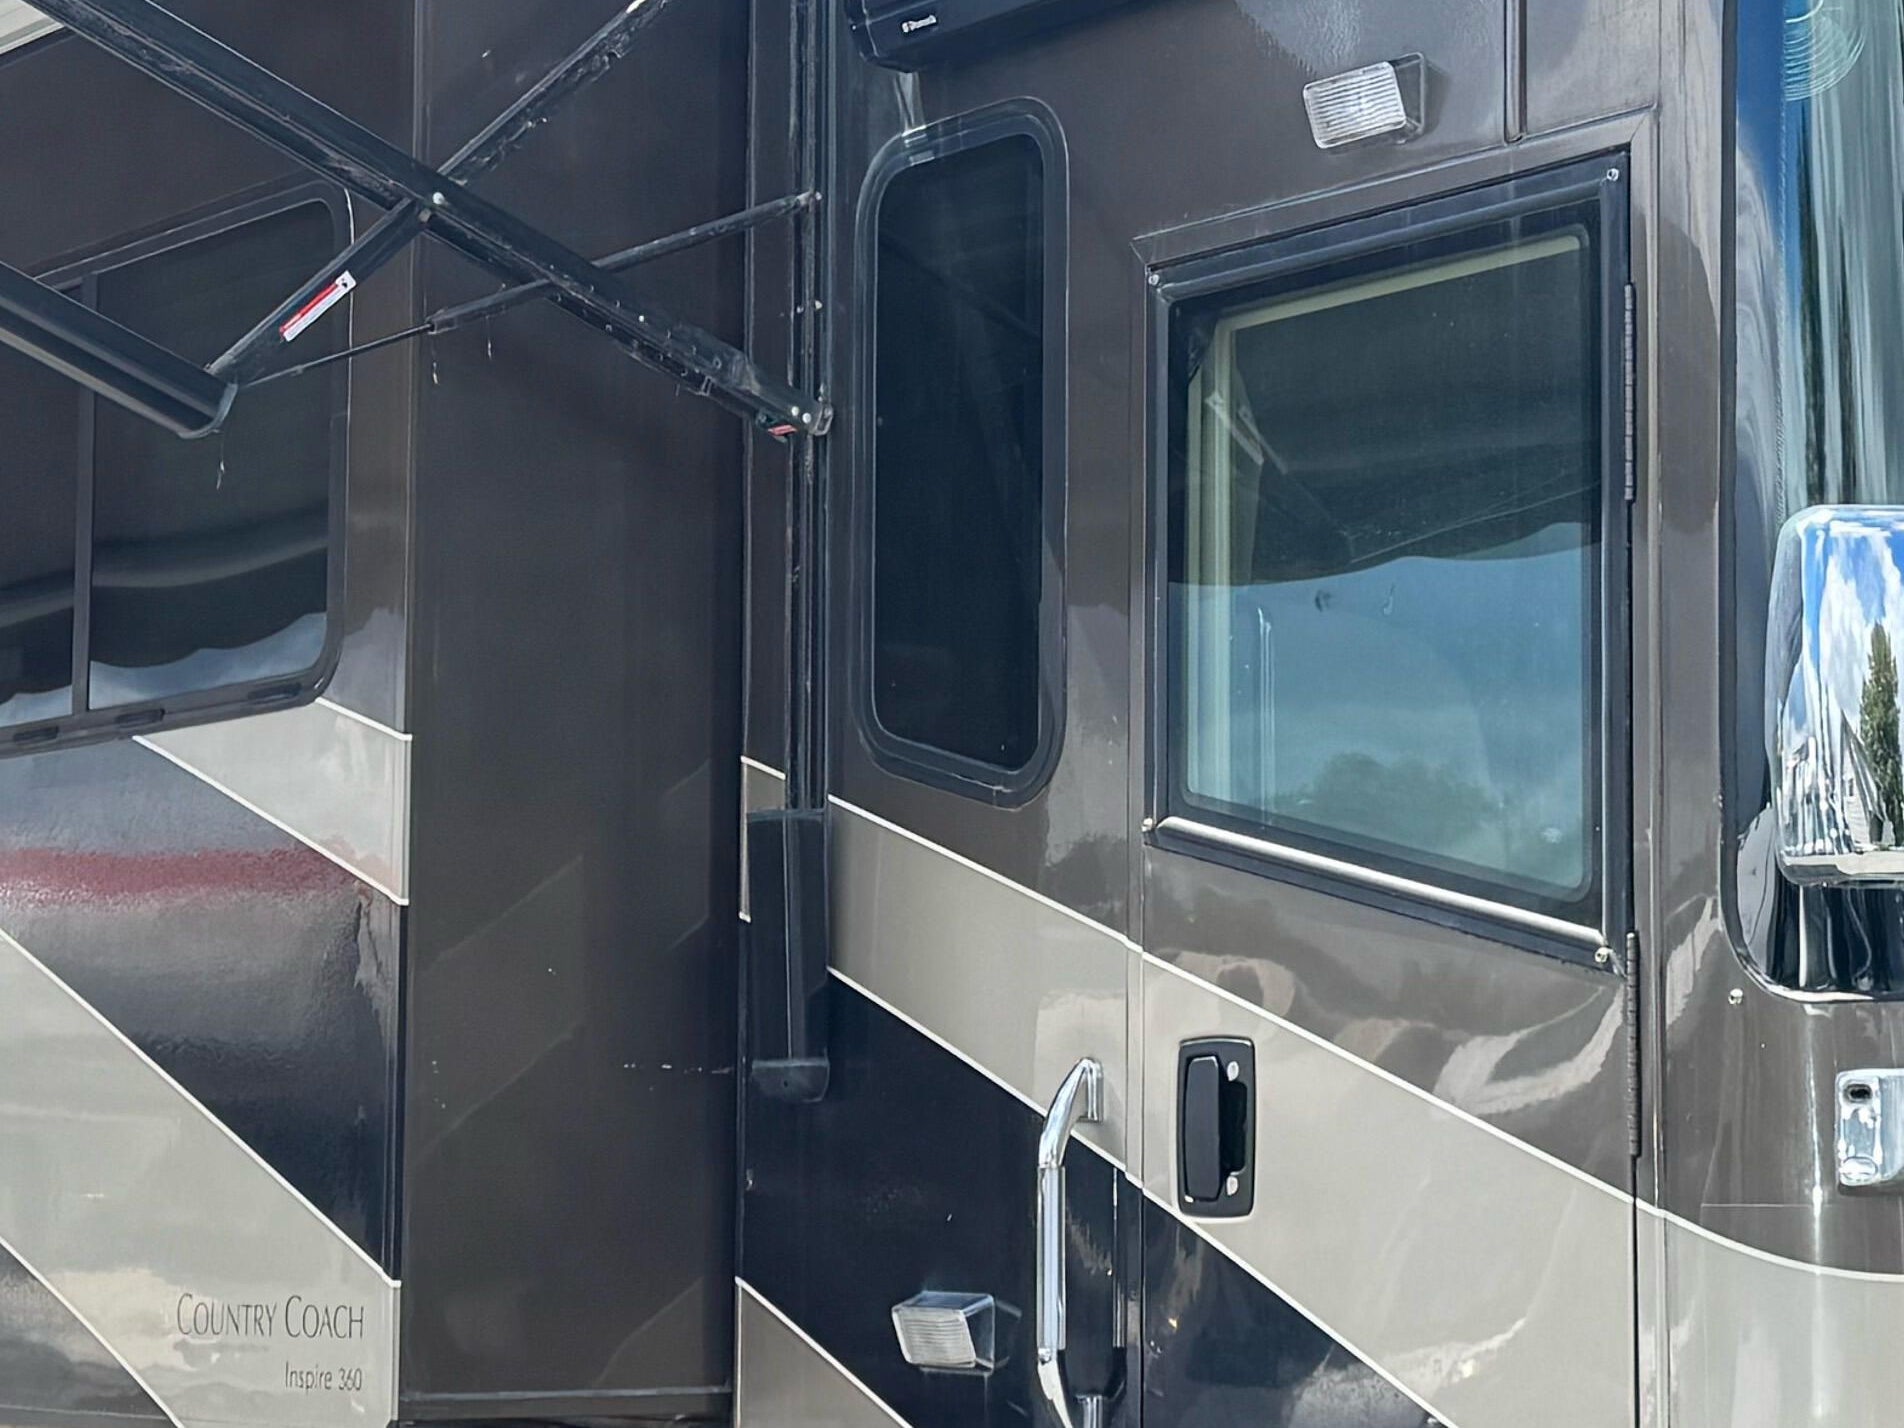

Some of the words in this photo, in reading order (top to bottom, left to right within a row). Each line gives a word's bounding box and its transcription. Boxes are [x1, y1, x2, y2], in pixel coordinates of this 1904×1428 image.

[176, 1292, 278, 1337] COUNTRY
[284, 1294, 365, 1340] COACH
[284, 1360, 333, 1395] Inspire
[338, 1367, 363, 1392] 360
